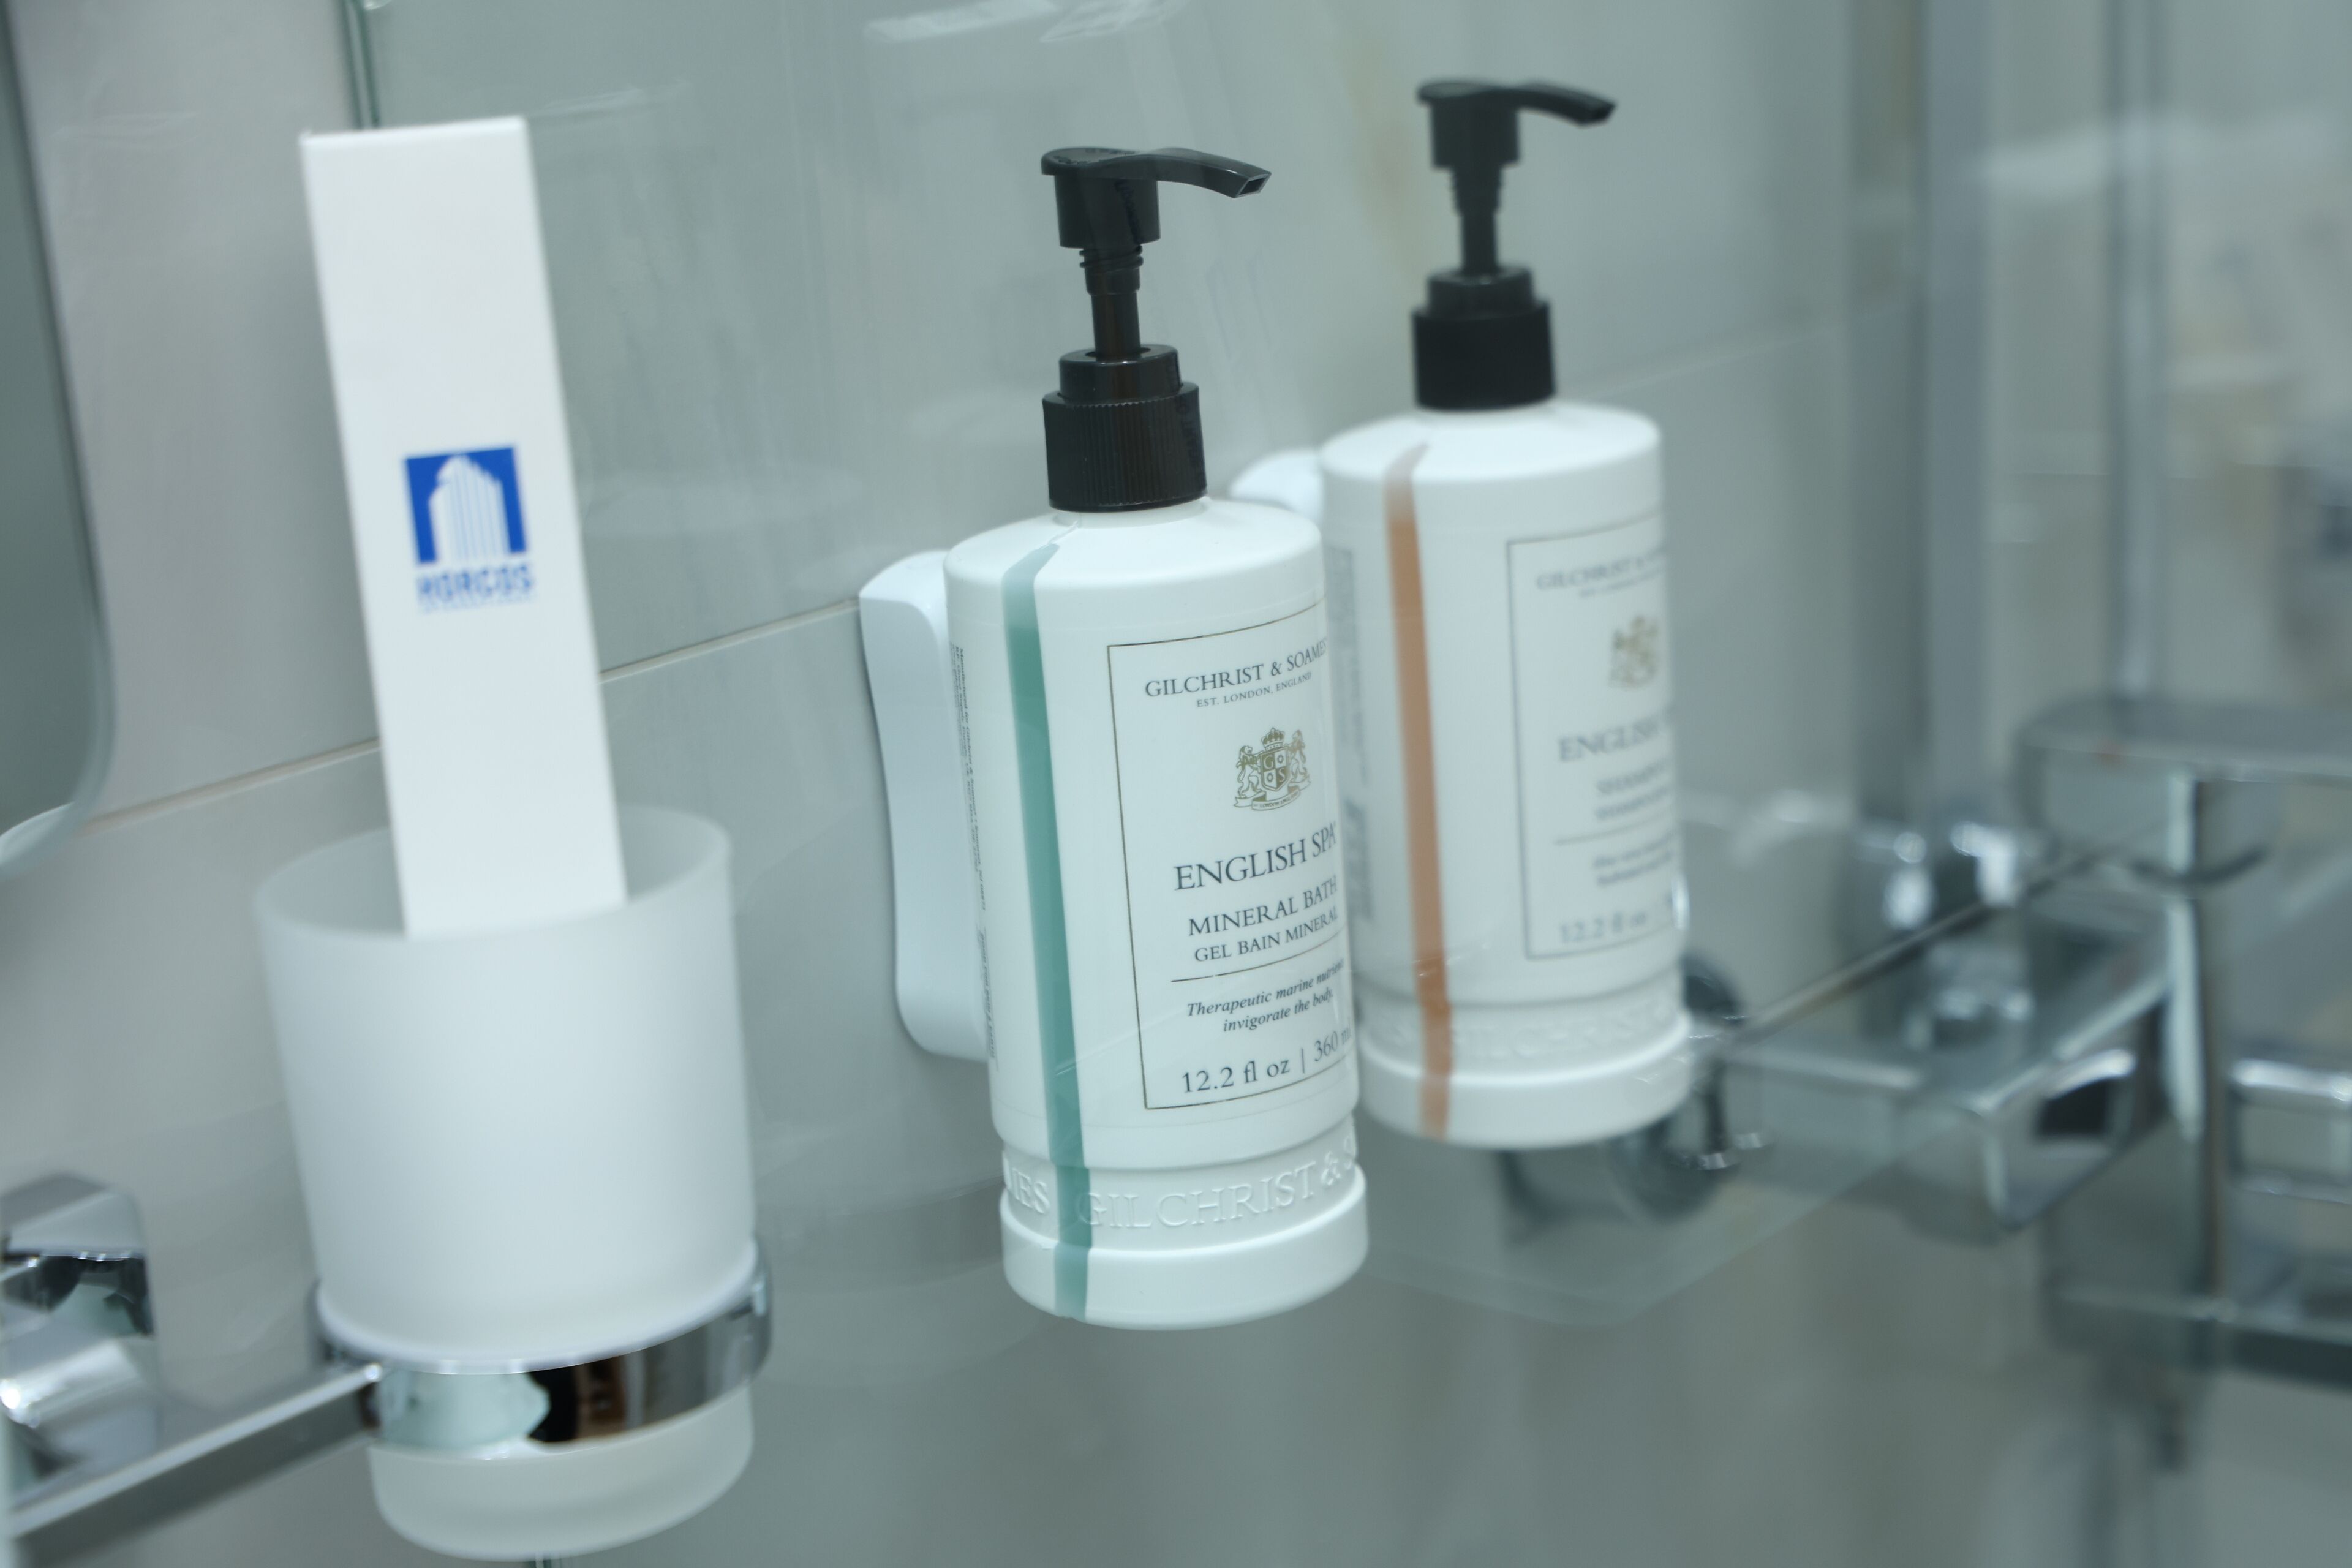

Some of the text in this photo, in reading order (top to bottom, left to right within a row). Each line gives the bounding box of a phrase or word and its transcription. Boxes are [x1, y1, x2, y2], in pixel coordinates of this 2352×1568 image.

[1145, 663, 1265, 697] GILCHRIST
[1270, 661, 1282, 677] &
[1196, 672, 1312, 708] EST. LONDON, ENGLAND
[1174, 839, 1307, 891] ENGLISH
[1188, 875, 1338, 936] MINERAL BATH
[1195, 906, 1338, 962] GEL BAIN MINERAL
[1187, 991, 1272, 1017] Therapeutic
[1276, 979, 1314, 1000] marine
[1223, 1007, 1291, 1031] invigorate
[1294, 996, 1310, 1014] the
[1182, 1066, 1235, 1093] 12.2
[1243, 1060, 1258, 1084] fl
[1267, 1059, 1291, 1078] oz
[1314, 1030, 1339, 1062] 360
[1076, 1161, 1316, 1229] GILCHRIST
